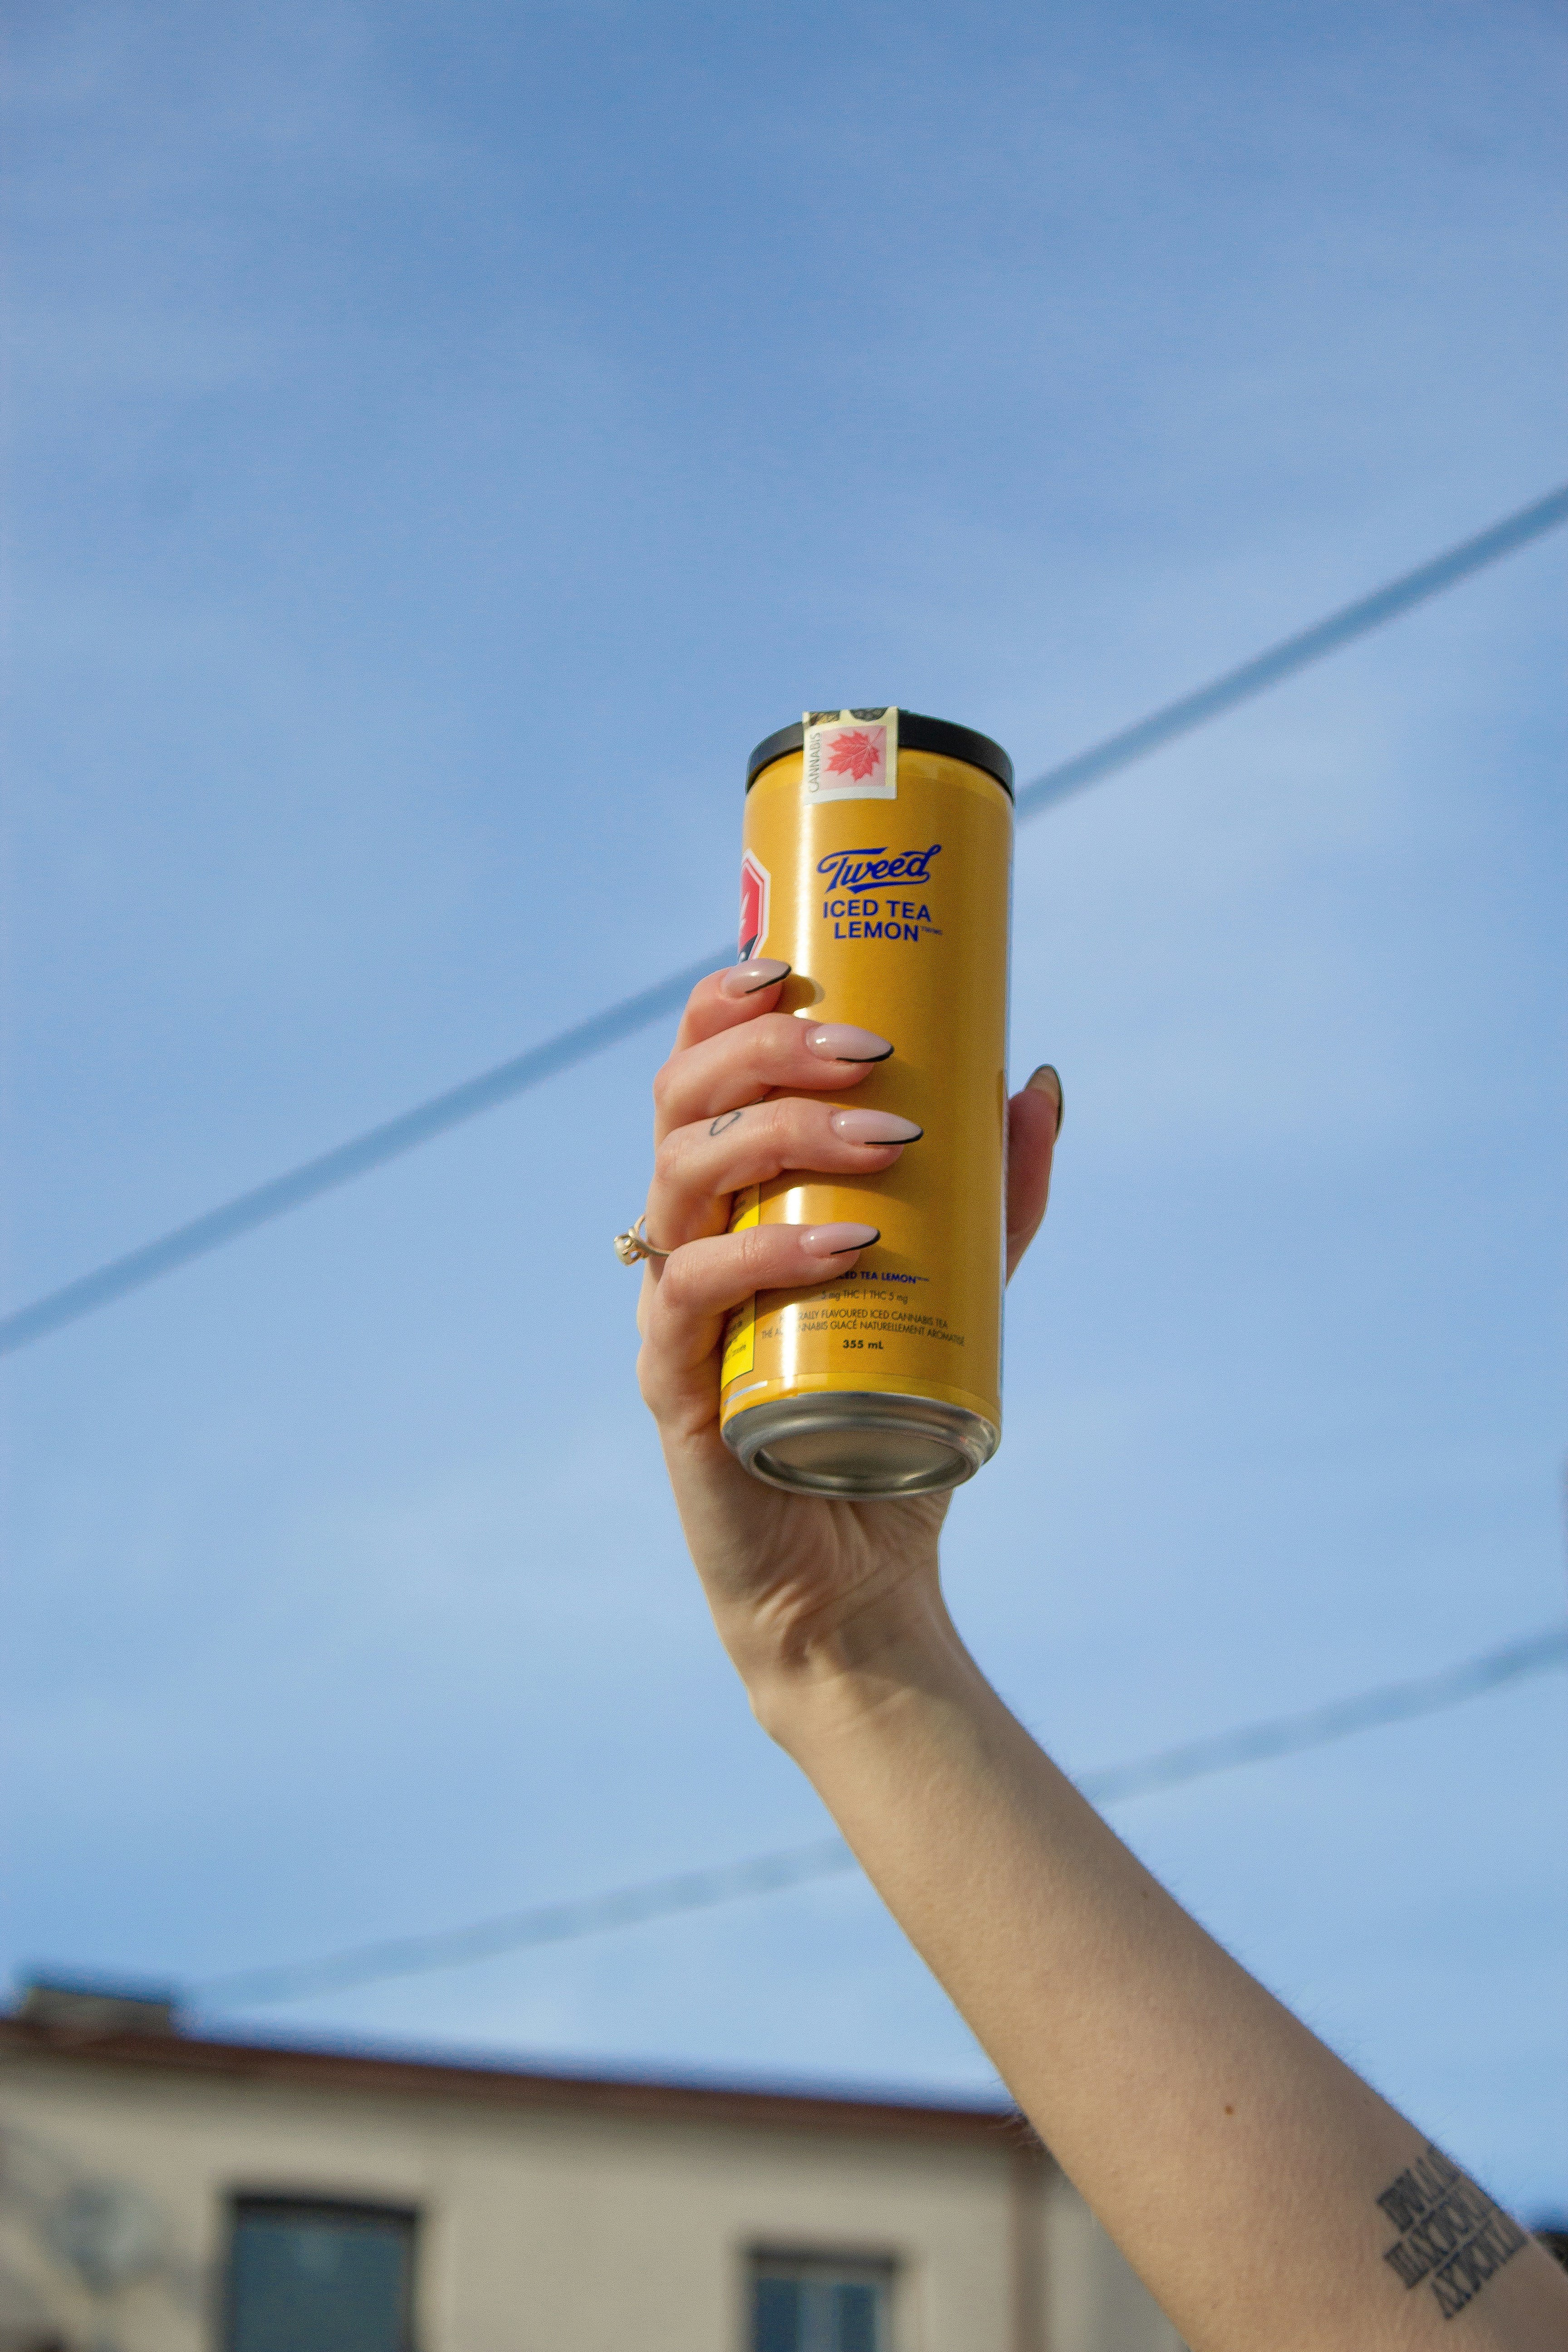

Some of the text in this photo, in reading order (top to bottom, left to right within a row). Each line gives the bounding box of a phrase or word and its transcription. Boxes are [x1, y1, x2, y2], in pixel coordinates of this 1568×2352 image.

[808, 732, 821, 793] CANNABIS
[816, 843, 942, 895] Tweed
[823, 899, 931, 923] ICED TEA
[861, 1271, 878, 1280] TEA
[843, 1289, 860, 1299] THC
[869, 1289, 886, 1301] THC
[888, 1291, 894, 1301] 5
[896, 1294, 908, 1305] mg
[762, 1326, 774, 1339] THÉ
[830, 1318, 857, 1330] GLACÉ
[860, 1321, 925, 1336] NATURELLEMENT
[821, 1308, 868, 1318] FLAVOURED
[870, 1309, 889, 1320] ICED
[891, 1310, 933, 1326] CANNABIS
[935, 1318, 948, 1329] TEA
[843, 1339, 884, 1350] 355 mL
